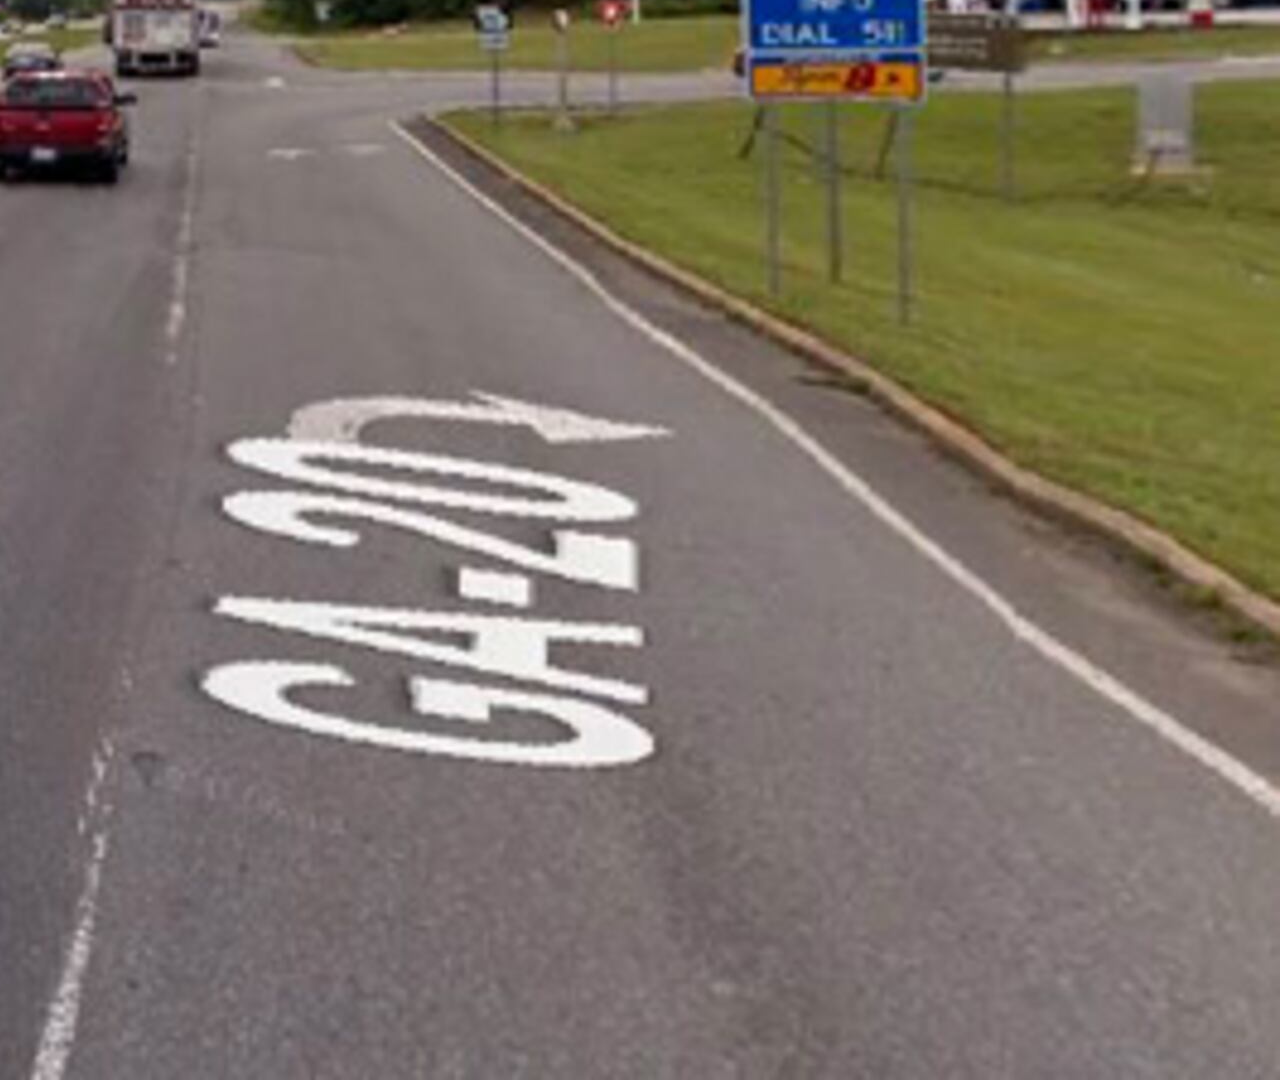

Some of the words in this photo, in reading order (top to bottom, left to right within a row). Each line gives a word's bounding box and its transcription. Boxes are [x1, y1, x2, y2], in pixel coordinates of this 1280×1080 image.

[761, 22, 838, 44] DIAL
[861, 21, 905, 44] 511
[200, 438, 654, 767] GA-20
